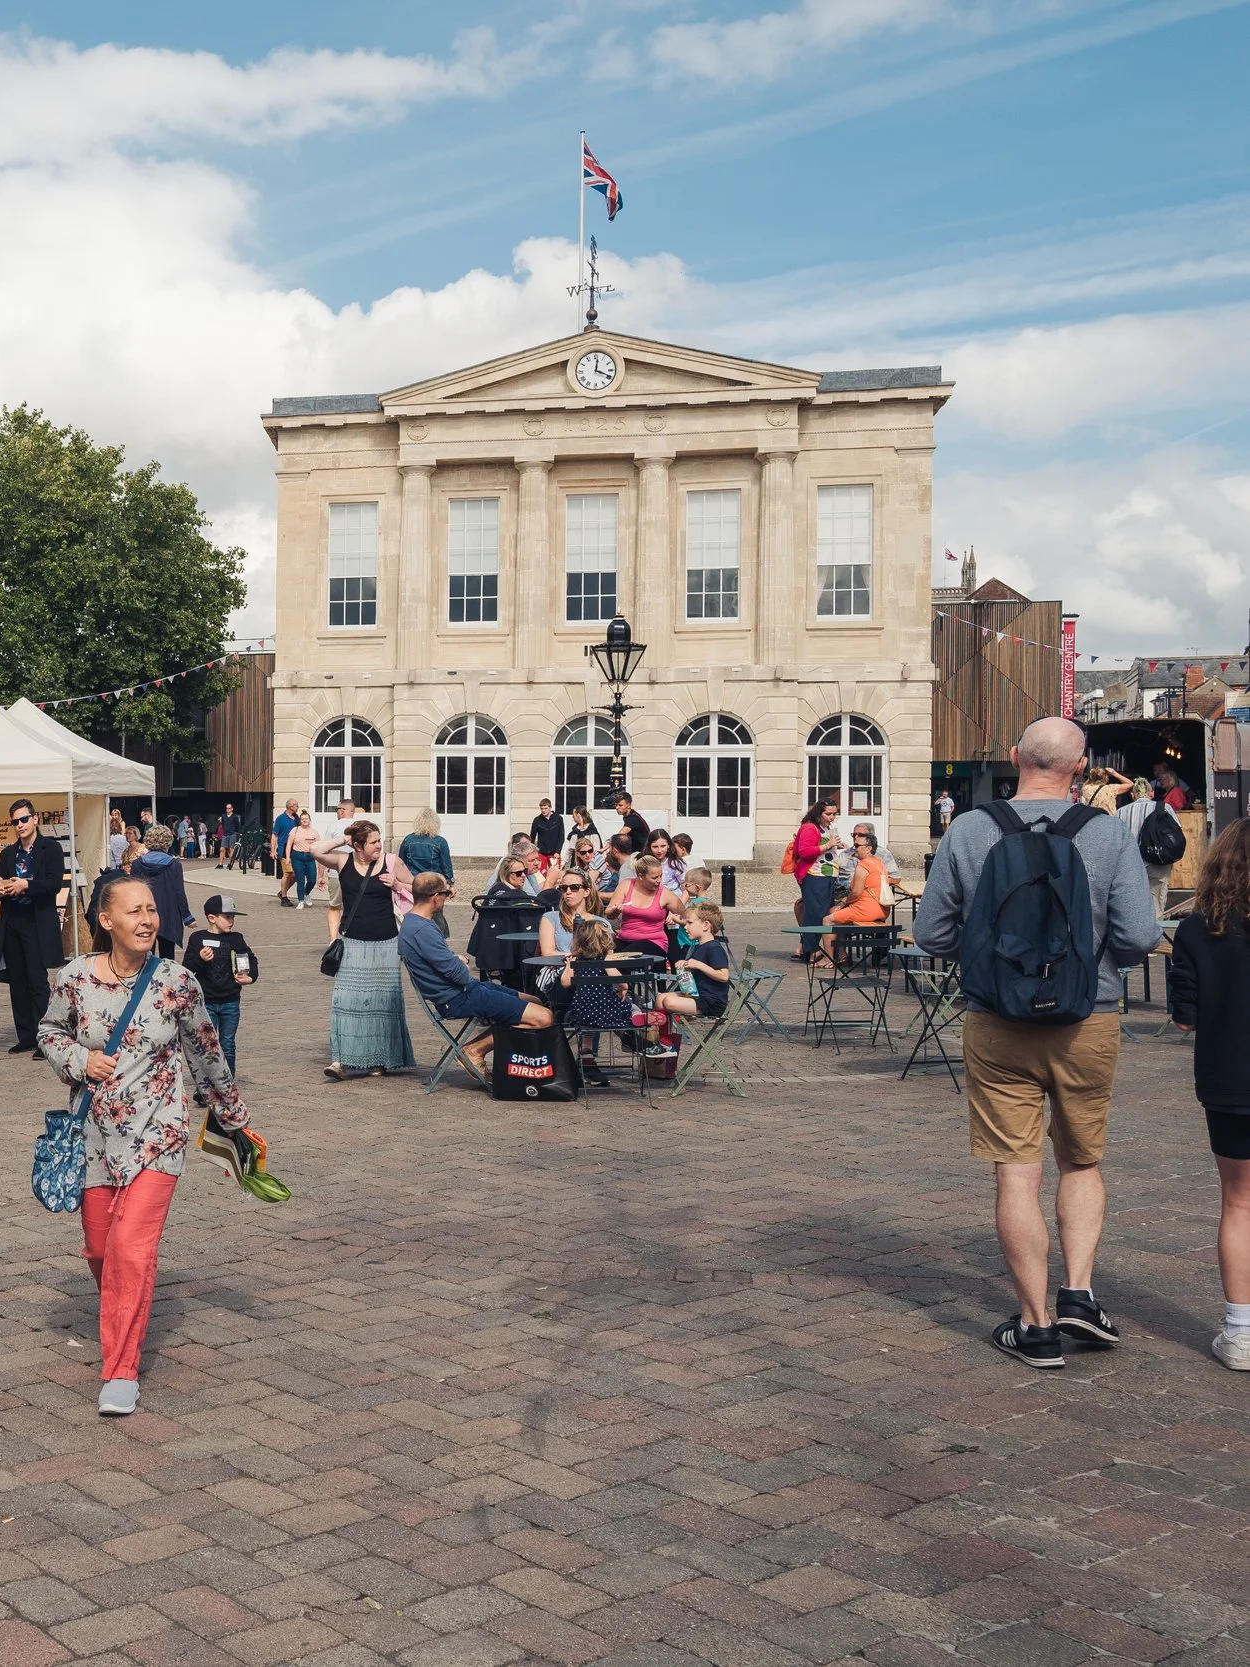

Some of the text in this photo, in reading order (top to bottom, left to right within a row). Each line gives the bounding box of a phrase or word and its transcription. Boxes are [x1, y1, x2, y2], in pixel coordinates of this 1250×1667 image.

[563, 416, 626, 432] 1825
[1064, 633, 1074, 717] CHANTRY CENTRE
[946, 764, 953, 775] 8
[511, 1053, 548, 1066] SPORTS
[510, 1065, 549, 1077] DIRECT
